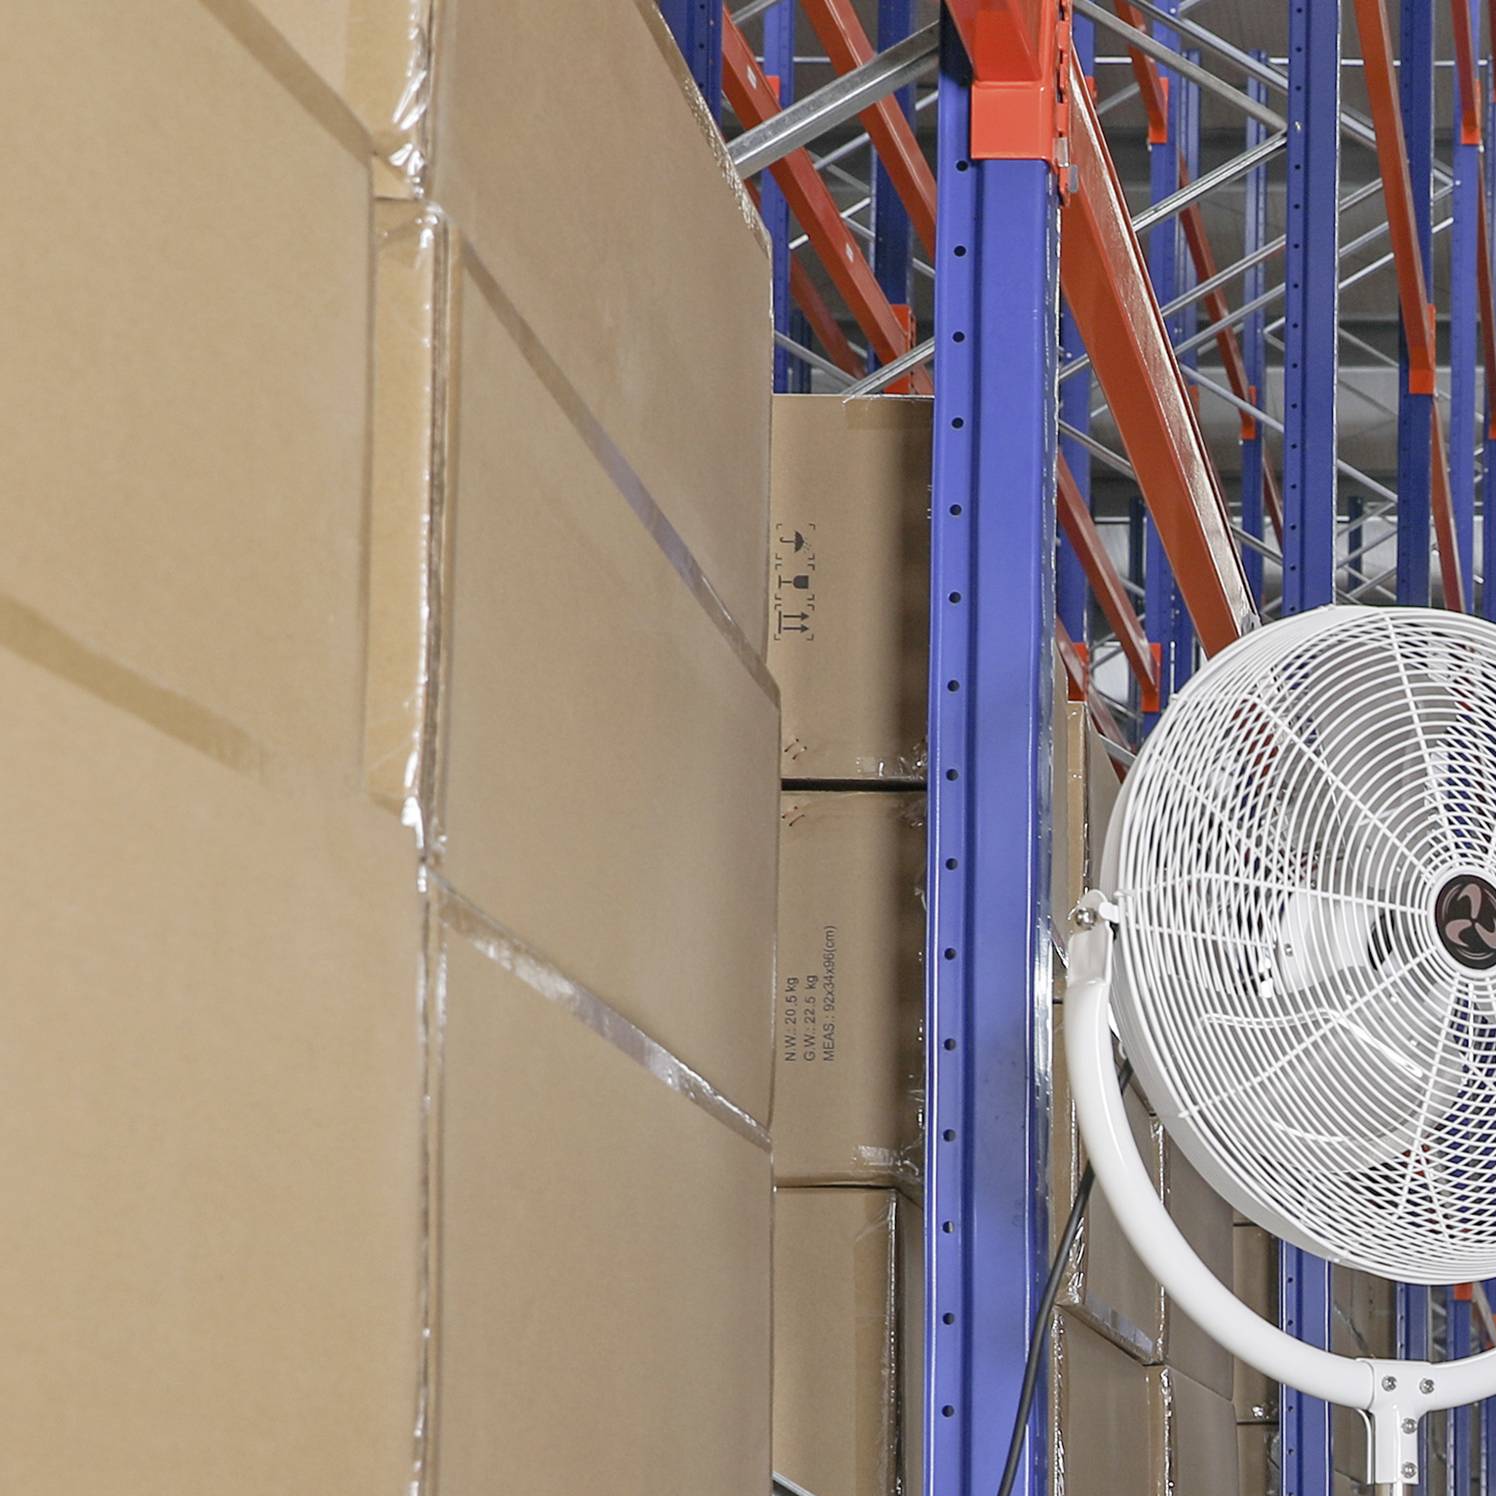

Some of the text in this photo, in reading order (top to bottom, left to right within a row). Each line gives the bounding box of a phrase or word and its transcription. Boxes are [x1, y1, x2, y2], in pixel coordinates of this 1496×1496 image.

[806, 975, 819, 990] kg
[823, 925, 837, 1012] 92x34x96(cm)
[785, 977, 799, 992] kg
[785, 995, 798, 1025] 20.5
[804, 996, 816, 1025] 22.5
